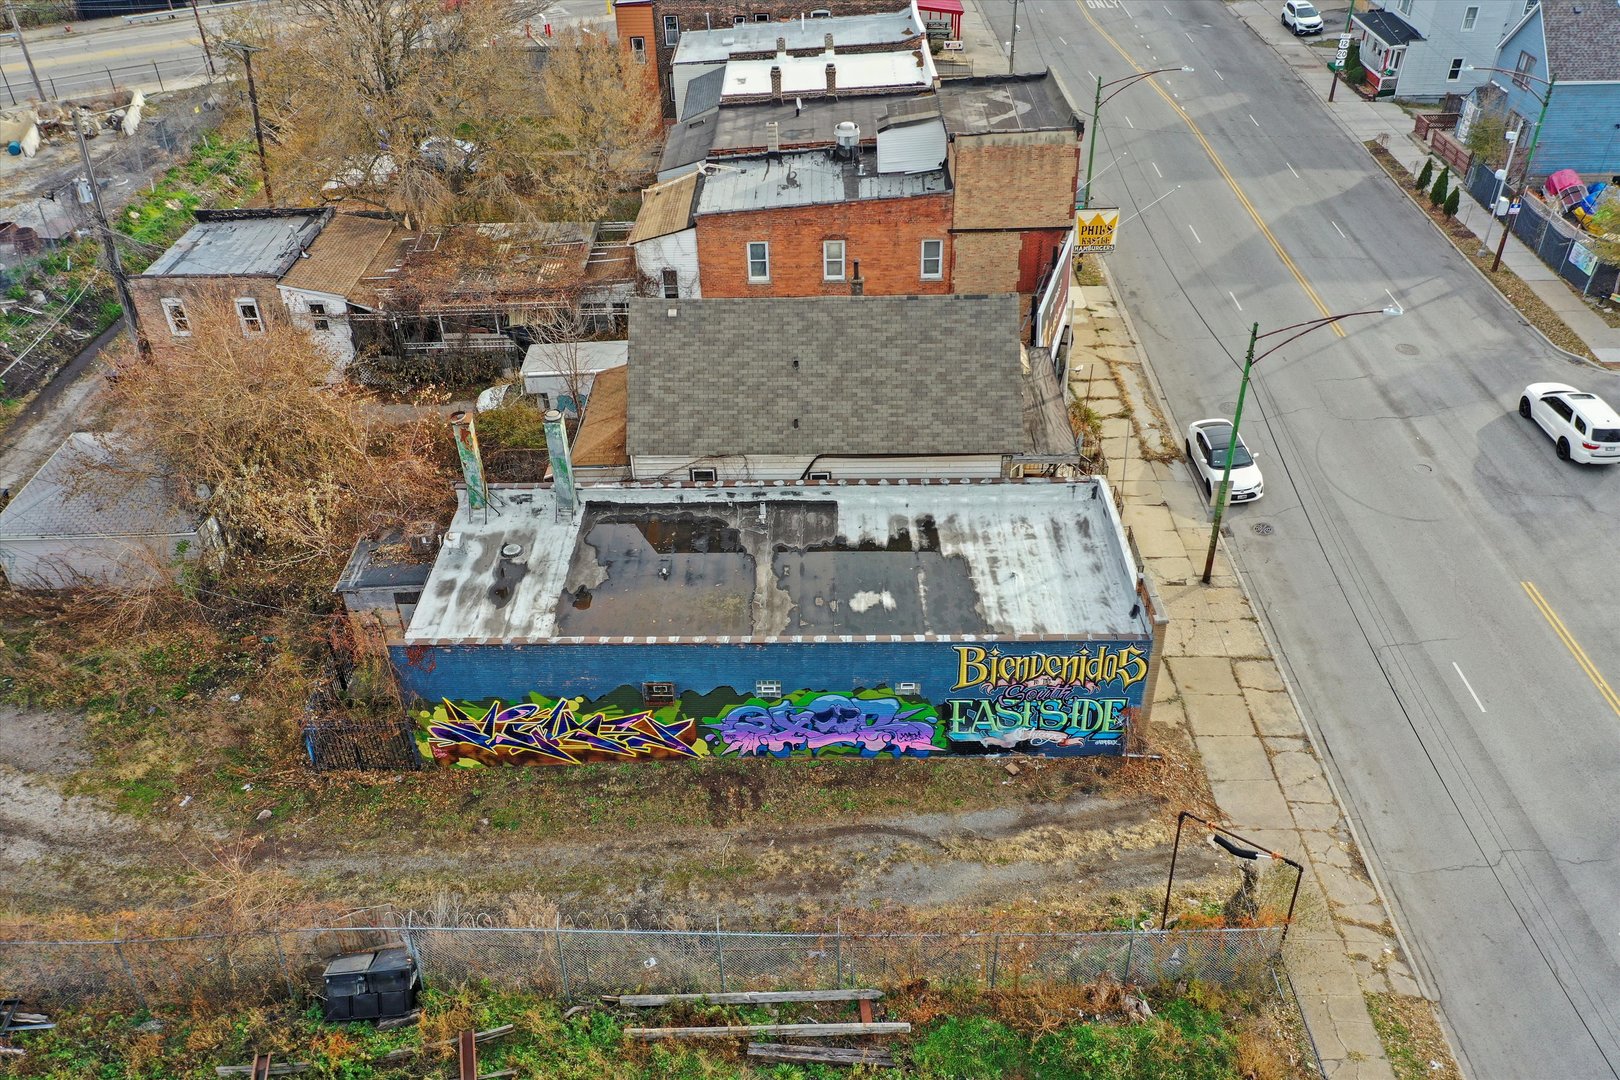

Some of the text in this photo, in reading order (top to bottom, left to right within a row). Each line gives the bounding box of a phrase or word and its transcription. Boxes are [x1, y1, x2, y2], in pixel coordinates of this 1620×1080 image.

[1086, 0, 1119, 9] ONLY
[1337, 50, 1347, 58] 20
[1080, 224, 1114, 236] PHIL'S
[1000, 683, 1074, 706] South
